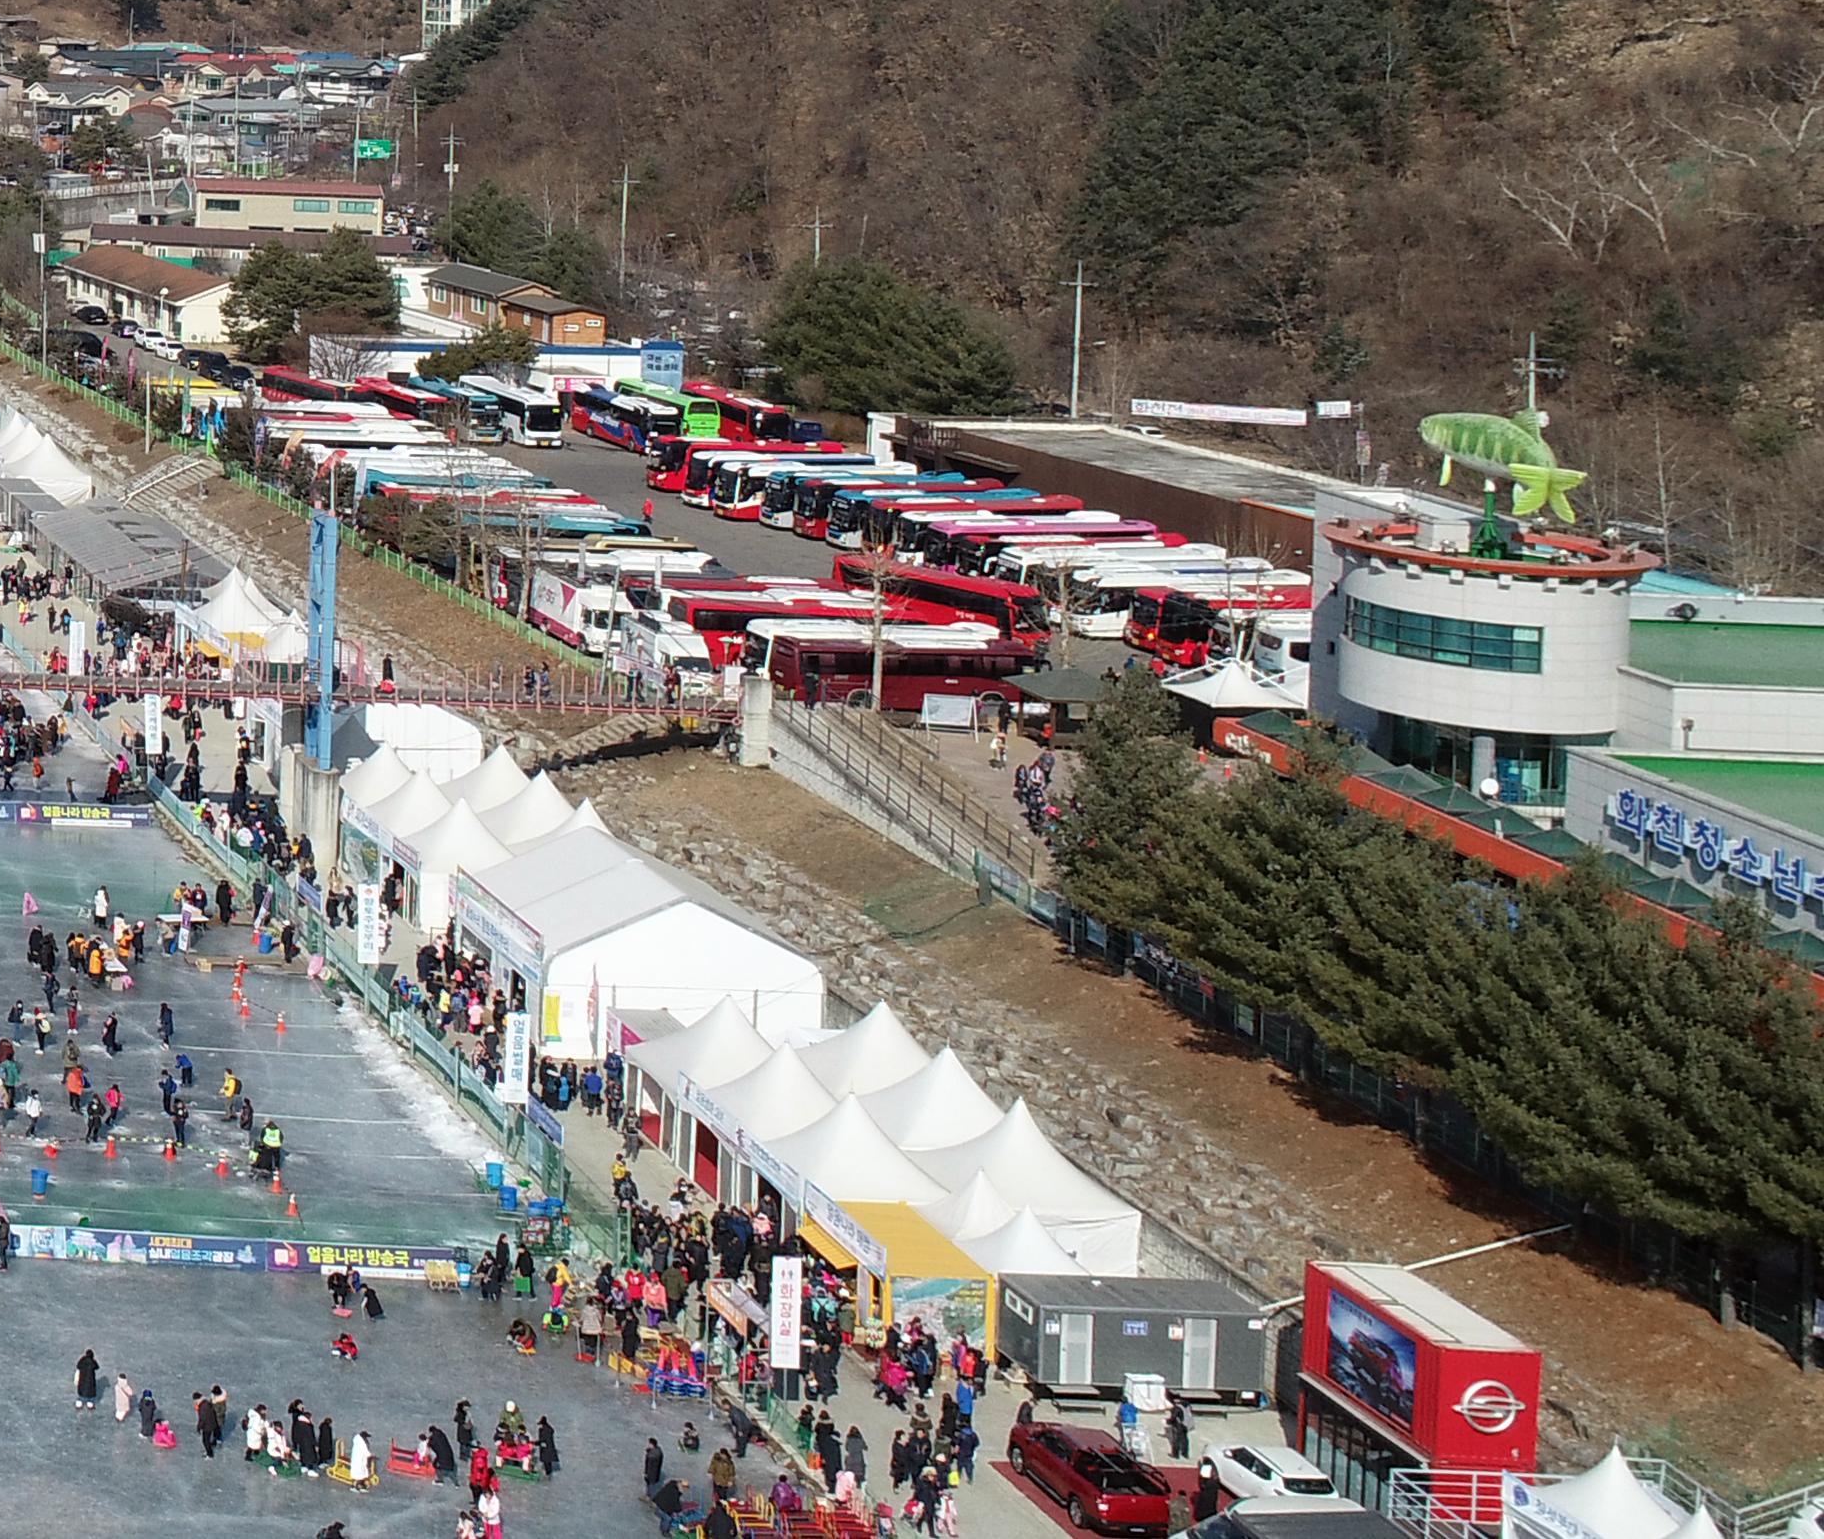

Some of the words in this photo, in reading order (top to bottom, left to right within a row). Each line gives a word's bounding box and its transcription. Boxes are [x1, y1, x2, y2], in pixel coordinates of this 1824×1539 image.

[306, 1247, 364, 1265] 얼음나라
[366, 1249, 410, 1267] 방송국
[779, 1283, 795, 1337] 화장실
